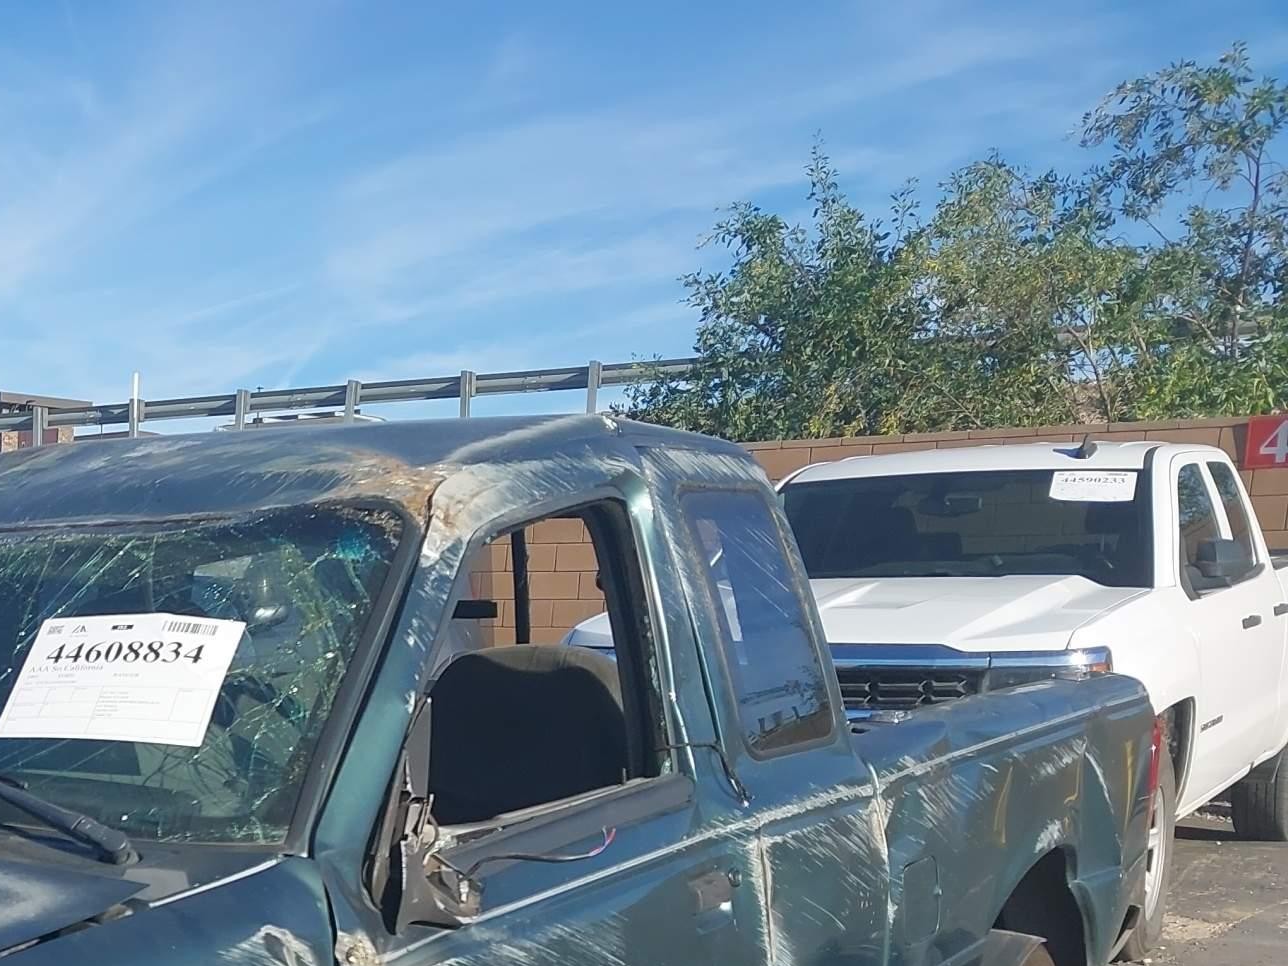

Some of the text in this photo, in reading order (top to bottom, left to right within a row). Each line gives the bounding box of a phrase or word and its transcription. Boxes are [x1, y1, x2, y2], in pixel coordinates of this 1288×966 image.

[1259, 420, 1288, 463] 4
[45, 640, 206, 664] 44608834
[63, 664, 104, 672] California
